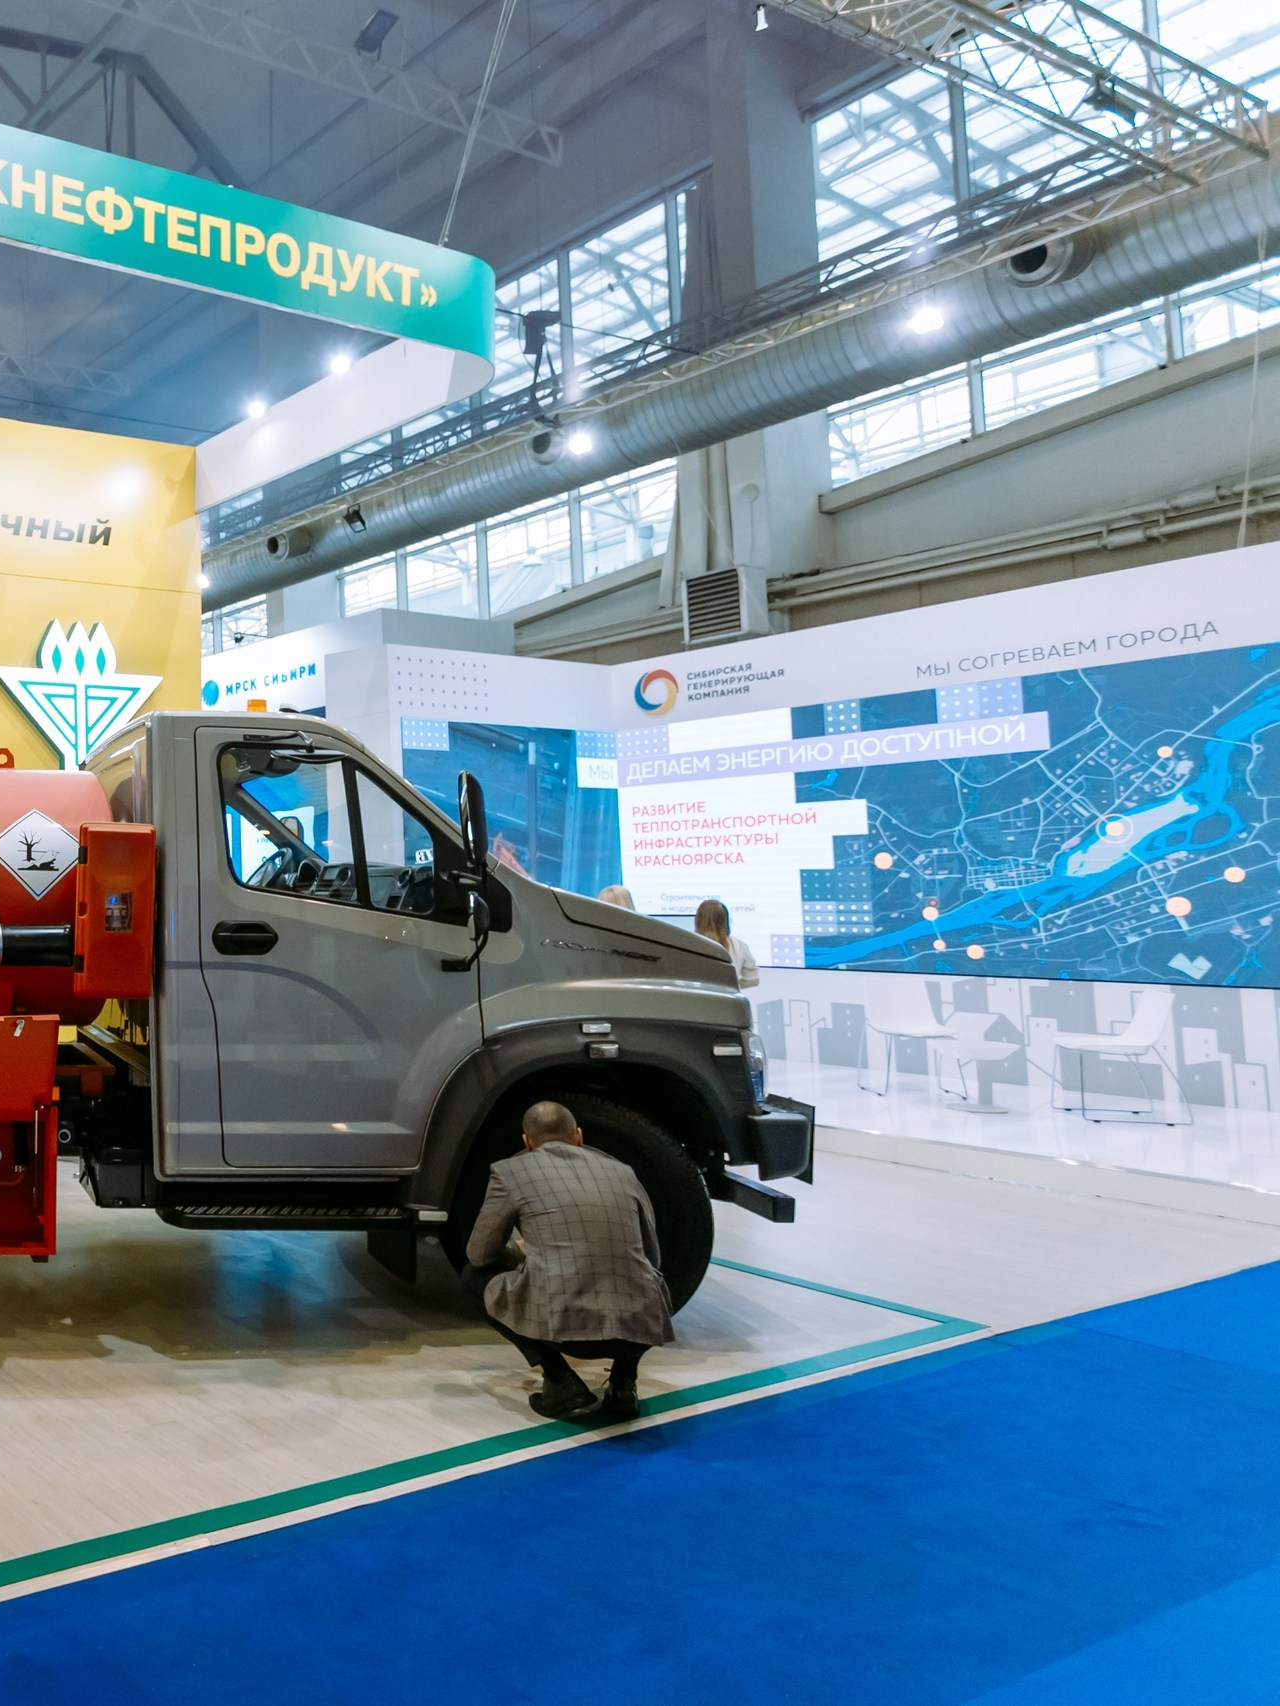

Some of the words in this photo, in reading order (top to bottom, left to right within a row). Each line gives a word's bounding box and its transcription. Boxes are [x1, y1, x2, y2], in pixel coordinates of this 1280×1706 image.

[916, 661, 951, 678] МЫ
[958, 638, 1097, 672] СОГРЕВАЕМ
[1106, 620, 1219, 650] ГОРОДА
[686, 662, 753, 681] СИБИРСКАЯ
[687, 668, 785, 691] ГЕНЕРИРУЮЩАЯ
[225, 678, 257, 697] МРСК
[687, 685, 750, 701] КОМПАНИЯ
[589, 764, 614, 781] МЫ
[626, 755, 710, 784] ДЕЛАЕМ
[716, 742, 833, 772] ЭНЕРГИЮ
[839, 716, 1026, 764] ДОСТУПНОЙ
[632, 801, 706, 818] РАЗВИТИЕ
[633, 807, 817, 834] ТЕПЛОТРАНСПОРТНОЙ
[633, 833, 780, 851] ИНФРАСТРУКТУРЫ
[634, 852, 745, 867] КРАСНОЯРСКА
